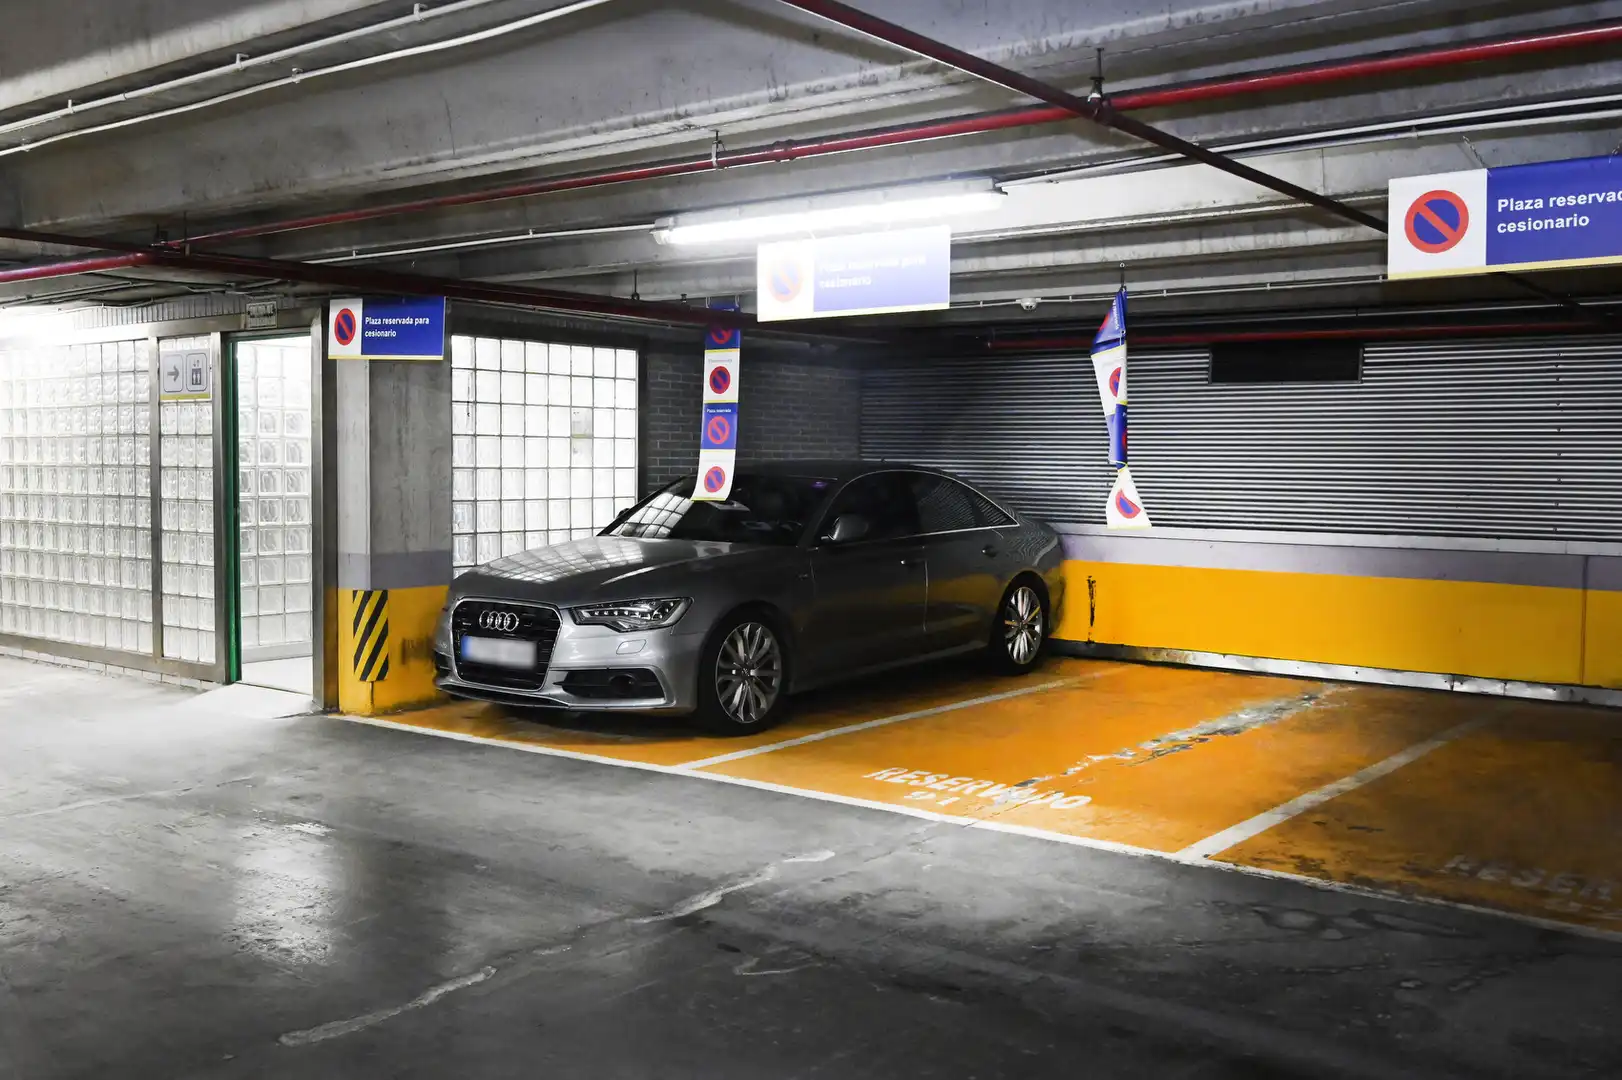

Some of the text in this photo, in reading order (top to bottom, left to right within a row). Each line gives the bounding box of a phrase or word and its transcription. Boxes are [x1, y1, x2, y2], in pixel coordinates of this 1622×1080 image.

[1497, 196, 1544, 213] Plaza
[1497, 213, 1590, 233] cesionario
[365, 316, 430, 326] Plaza reservada para
[365, 329, 397, 337] cesionario
